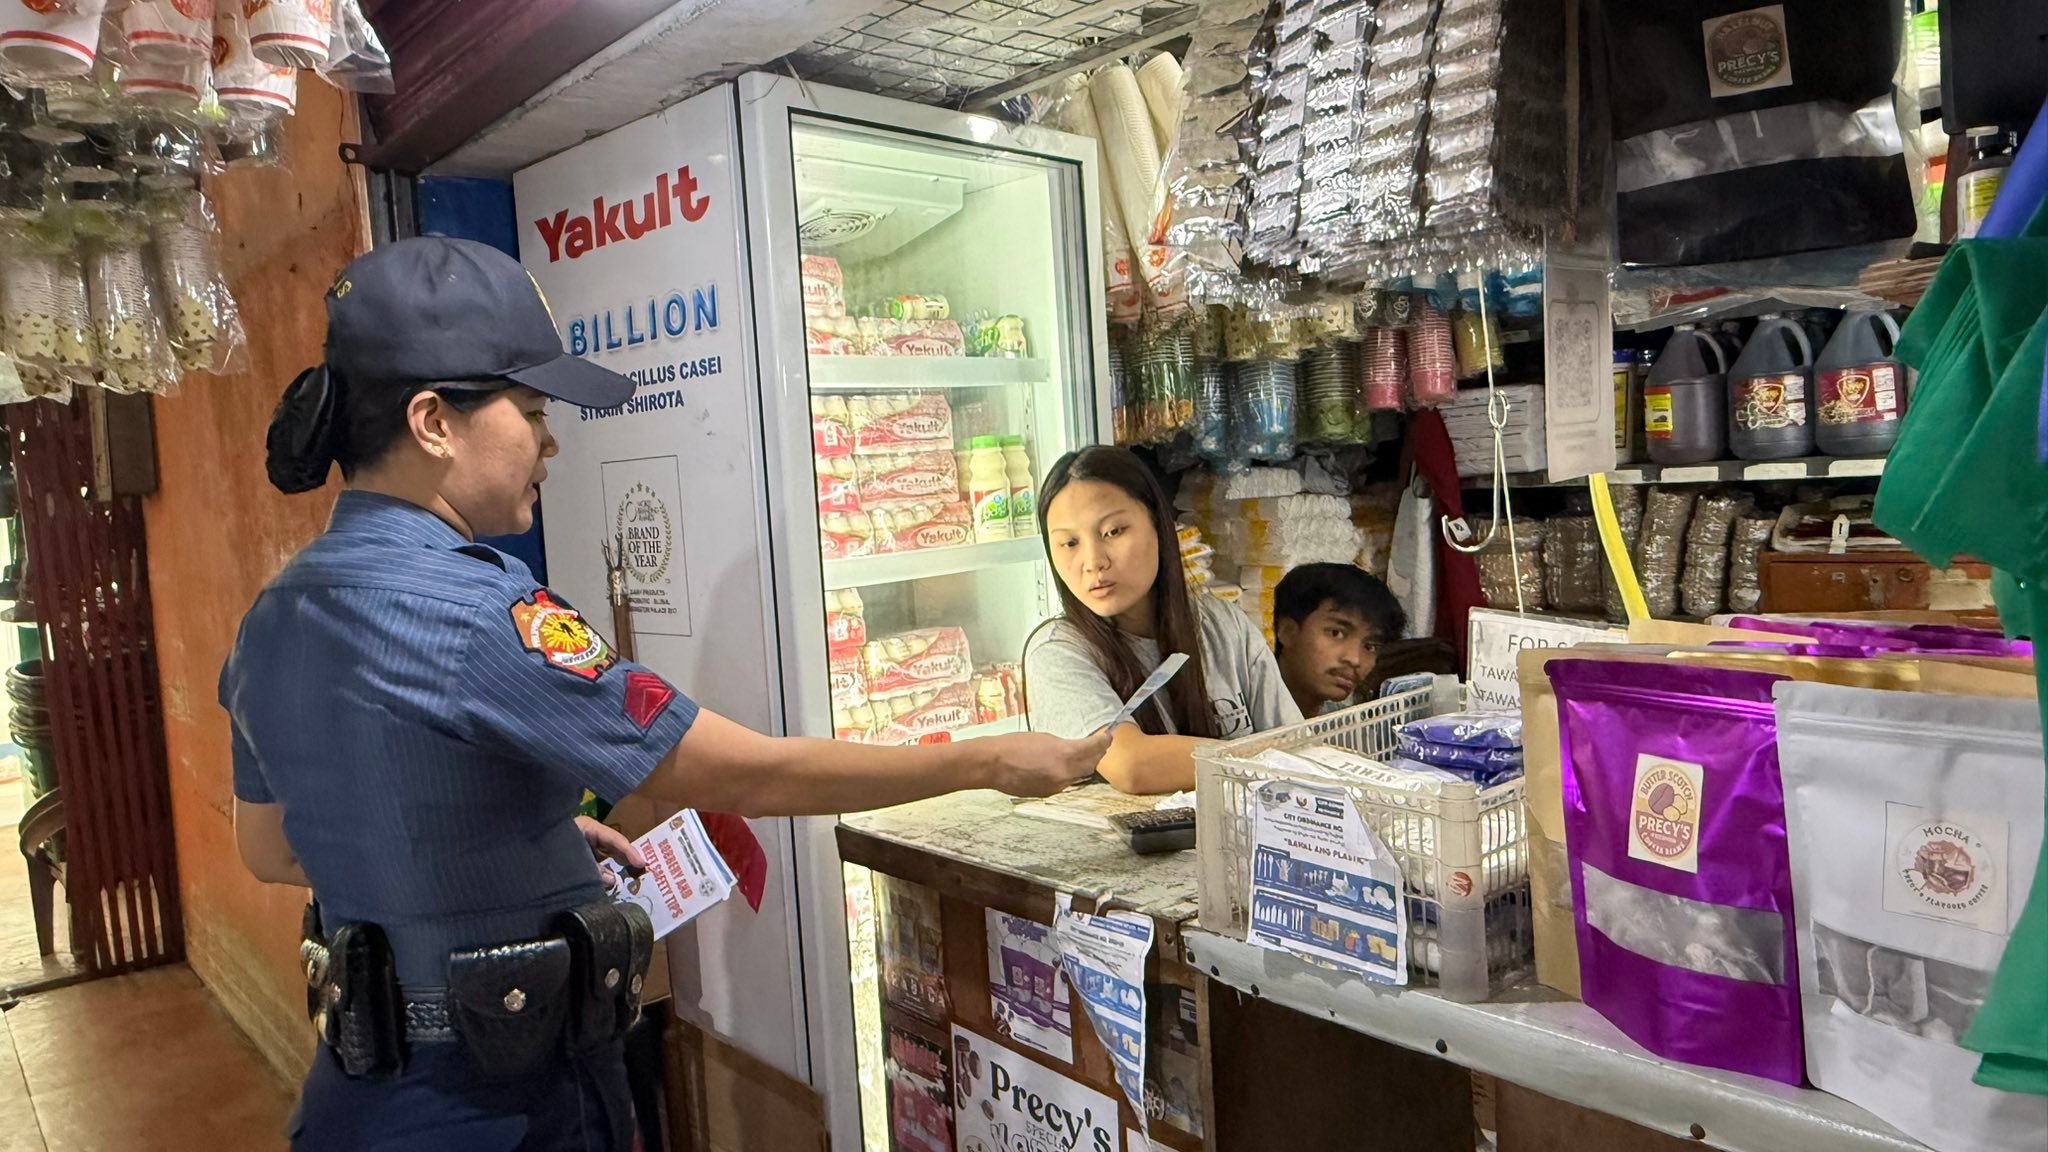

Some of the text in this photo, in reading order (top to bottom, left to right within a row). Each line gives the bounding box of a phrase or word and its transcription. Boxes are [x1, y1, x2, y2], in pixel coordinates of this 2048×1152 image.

[1718, 51, 1780, 72] PRECY'S
[534, 165, 710, 263] Yakult
[569, 283, 720, 357] BILLION
[905, 343, 950, 356] Yakult
[679, 355, 722, 381] CASEI
[627, 389, 685, 415] SHIROTA
[628, 526, 660, 540] BRAND
[919, 527, 964, 545] Yakult
[628, 540, 662, 554] OF THE
[634, 554, 658, 568] YEAR
[913, 659, 958, 676] Yakult
[1480, 664, 1518, 682] TAWA
[1480, 688, 1521, 709] TAWA
[916, 709, 963, 729] Yakult
[1338, 760, 1398, 783] TAWAS
[1640, 769, 1694, 800] BUTTER SCOTCH
[1639, 815, 1691, 840] PRECY'S
[1922, 825, 1970, 844] MOCHA
[664, 894, 684, 919] TIPS
[989, 1059, 1112, 1152] Precy's
